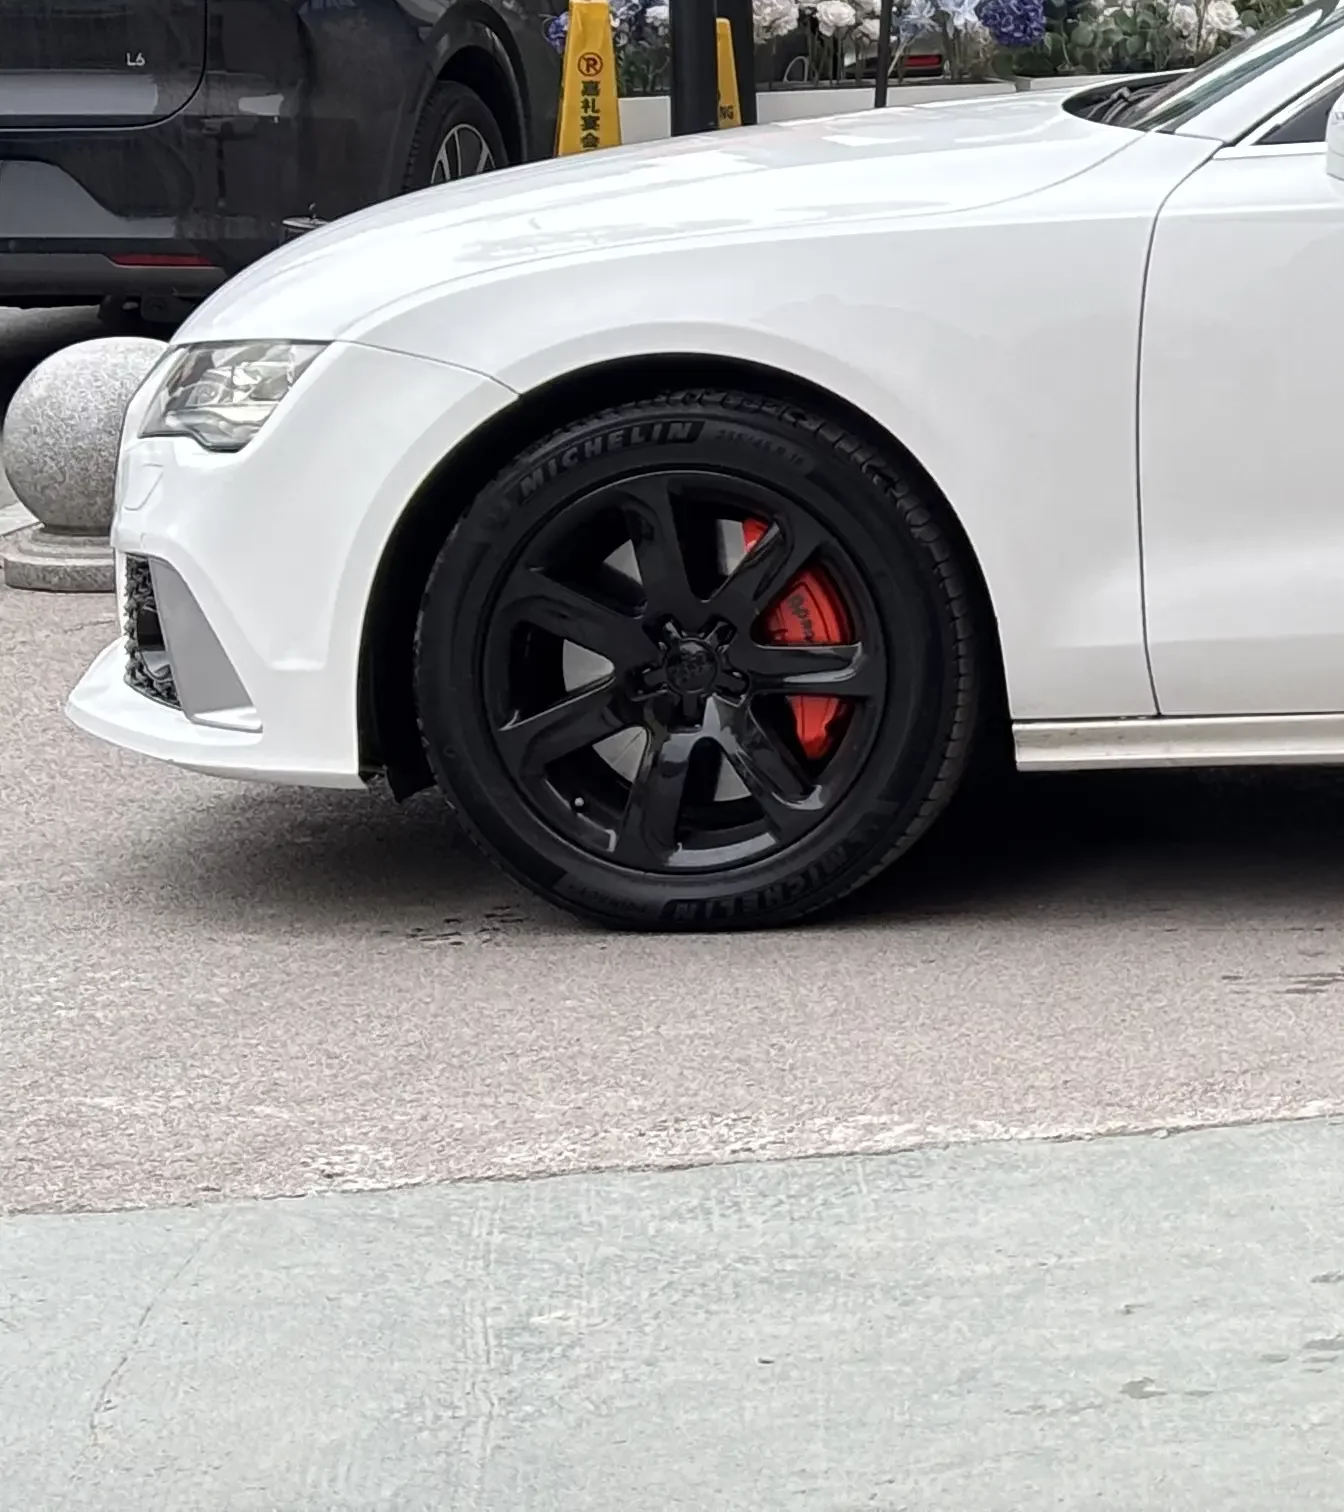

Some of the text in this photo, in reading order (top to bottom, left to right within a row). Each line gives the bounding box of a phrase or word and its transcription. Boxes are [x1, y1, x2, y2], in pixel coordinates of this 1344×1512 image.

[126, 52, 146, 66] L6
[518, 420, 694, 498] MICHELIN
[673, 845, 849, 921] MICHELIN
